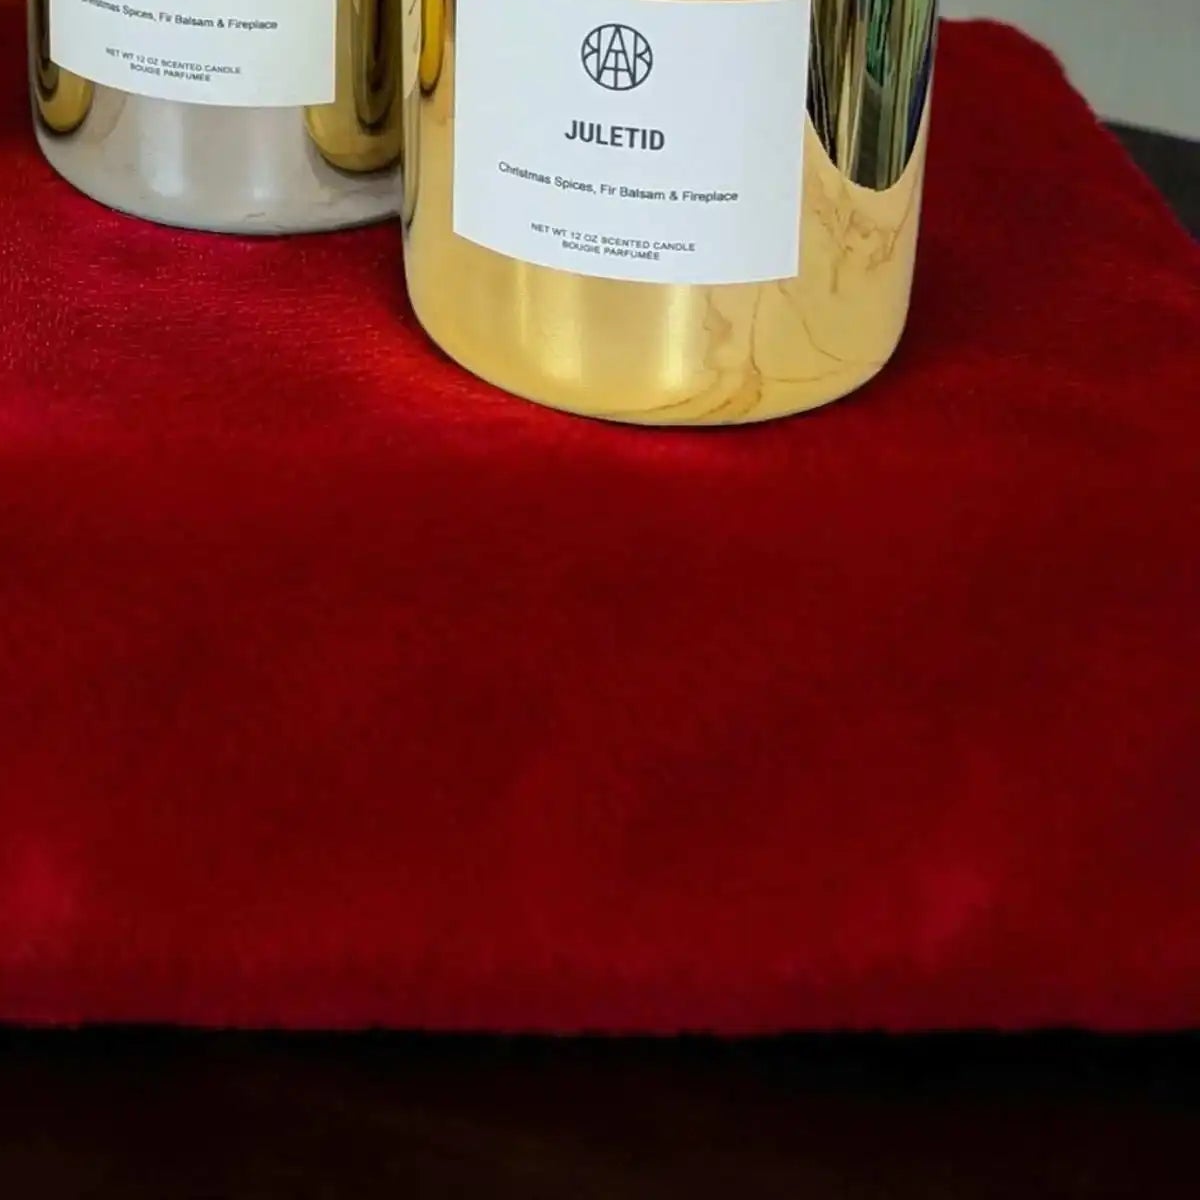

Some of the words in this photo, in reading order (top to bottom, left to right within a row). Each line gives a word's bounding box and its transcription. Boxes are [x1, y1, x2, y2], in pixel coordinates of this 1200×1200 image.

[122, 4, 156, 22] Spices,
[159, 12, 172, 24] Fir
[175, 14, 214, 28] Balsam
[217, 19, 224, 28] &
[228, 18, 278, 31] Fireplace
[148, 57, 158, 65] OZ
[161, 59, 202, 71] SCENTED
[205, 65, 241, 74] CANDLE
[564, 120, 665, 150] JULETID
[498, 161, 551, 185] Christmas
[554, 176, 597, 194] Spices,
[600, 183, 616, 195] Fir
[620, 186, 666, 201] Balsam
[669, 190, 678, 201] &
[682, 190, 738, 204] Fireplace
[531, 223, 550, 233] NET
[552, 227, 568, 237] WT
[571, 230, 581, 240] 12
[584, 233, 598, 243] OZ
[601, 236, 651, 249] SCENTED
[653, 241, 695, 252] CANDLE
[562, 240, 601, 253] BOUGIE
